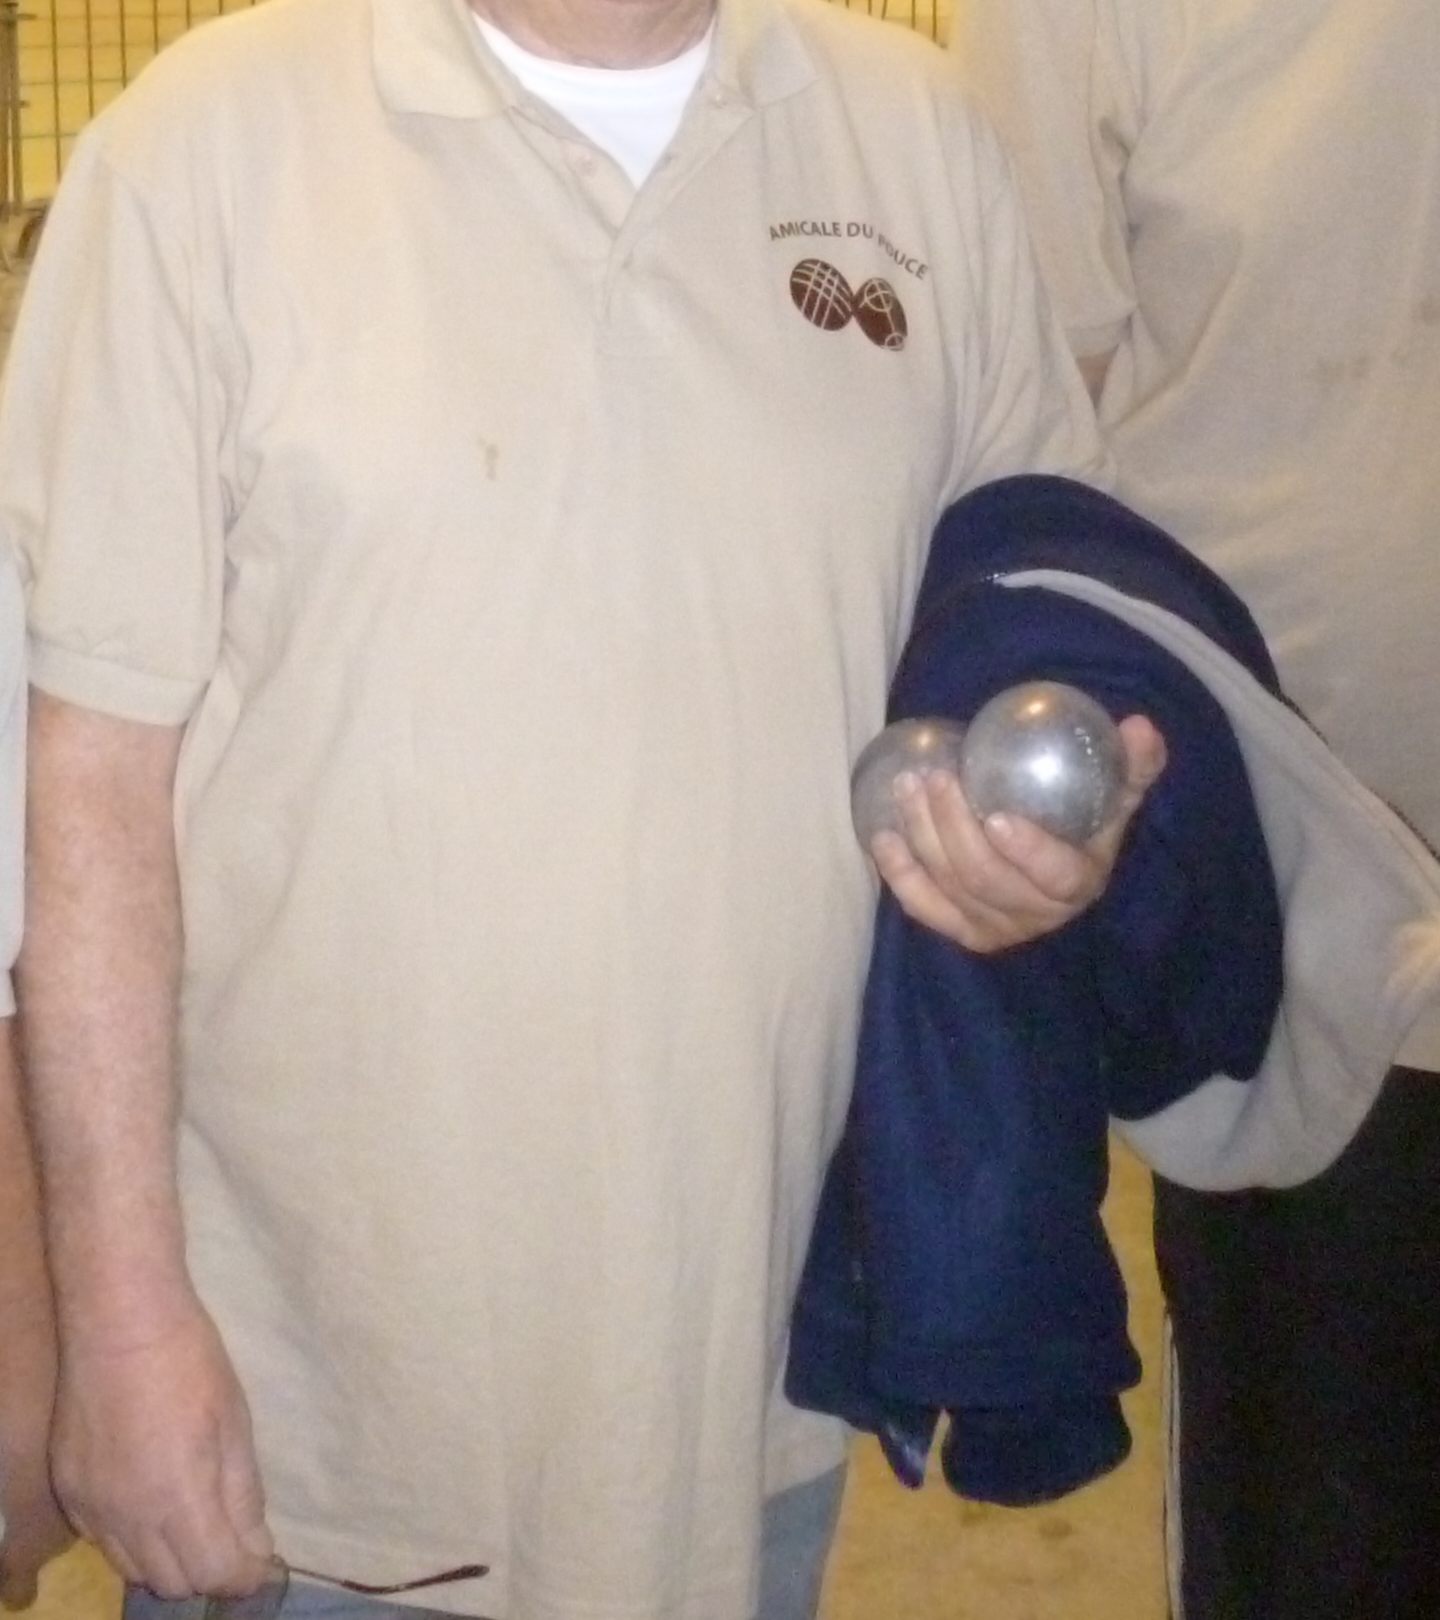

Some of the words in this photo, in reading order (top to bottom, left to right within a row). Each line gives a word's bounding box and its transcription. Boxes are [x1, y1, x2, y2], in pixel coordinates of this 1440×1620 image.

[769, 221, 842, 242] AMICALE
[846, 221, 875, 239] DU
[877, 233, 929, 281] POUCE
